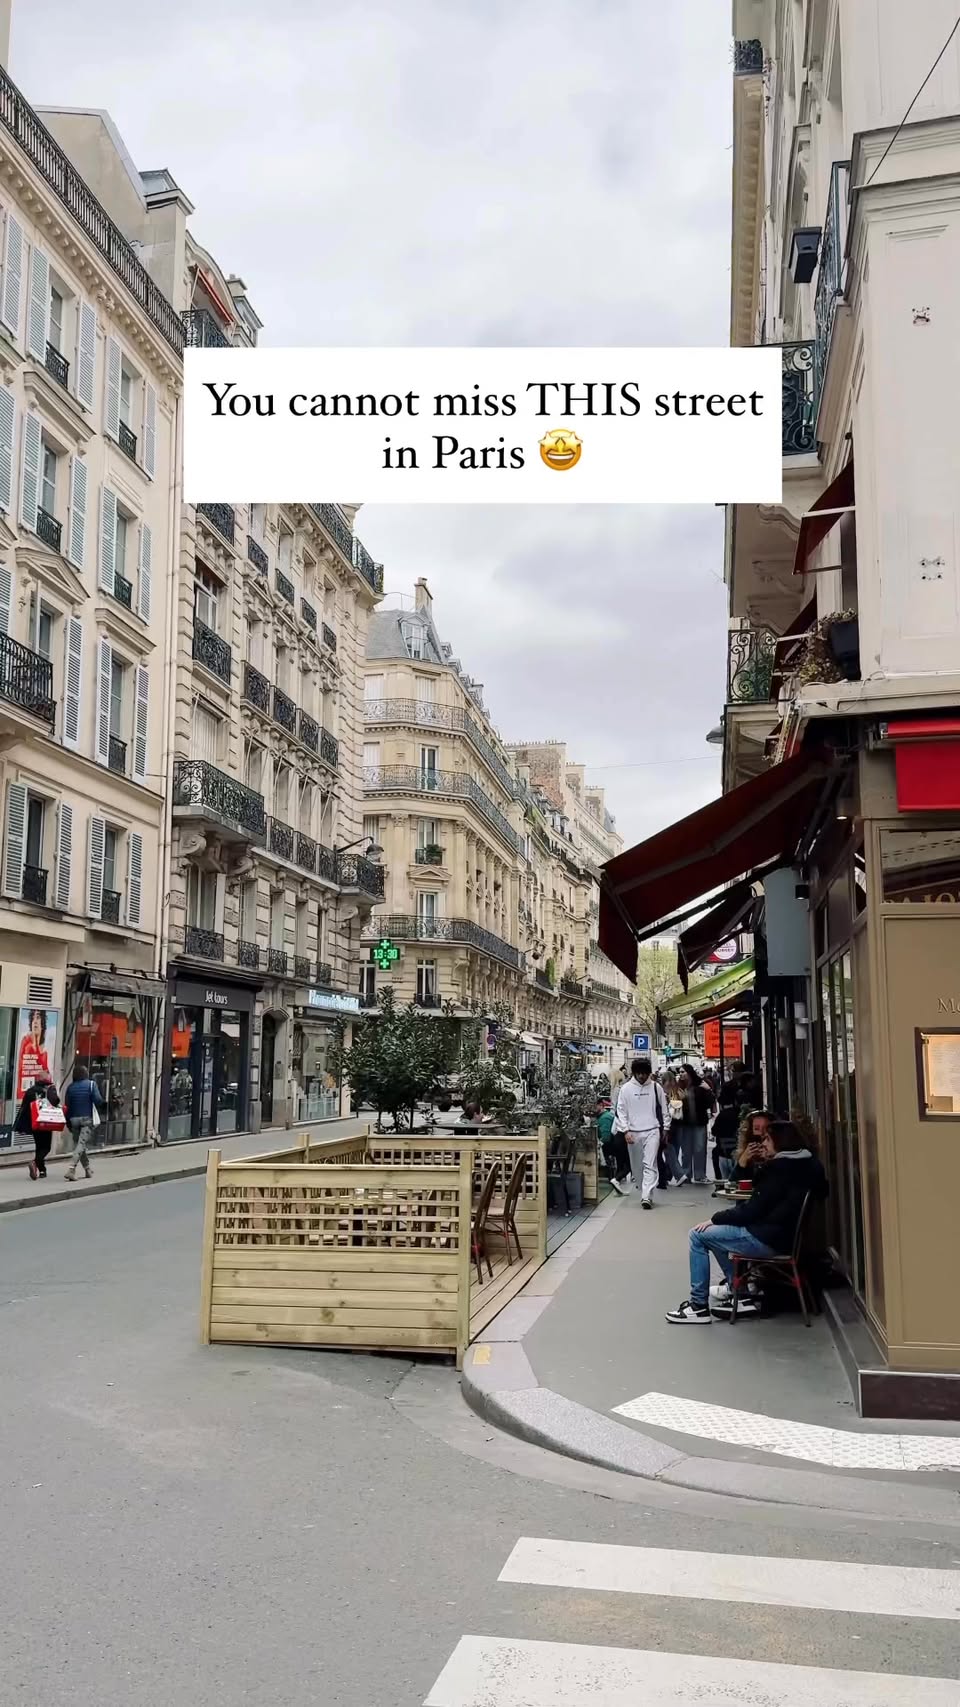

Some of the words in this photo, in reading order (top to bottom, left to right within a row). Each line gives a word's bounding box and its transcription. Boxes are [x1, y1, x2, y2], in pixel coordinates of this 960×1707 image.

[373, 949, 398, 959] 13:30
[205, 990, 214, 1003] Jet
[214, 991, 228, 1005] tours
[637, 1037, 645, 1048] P
